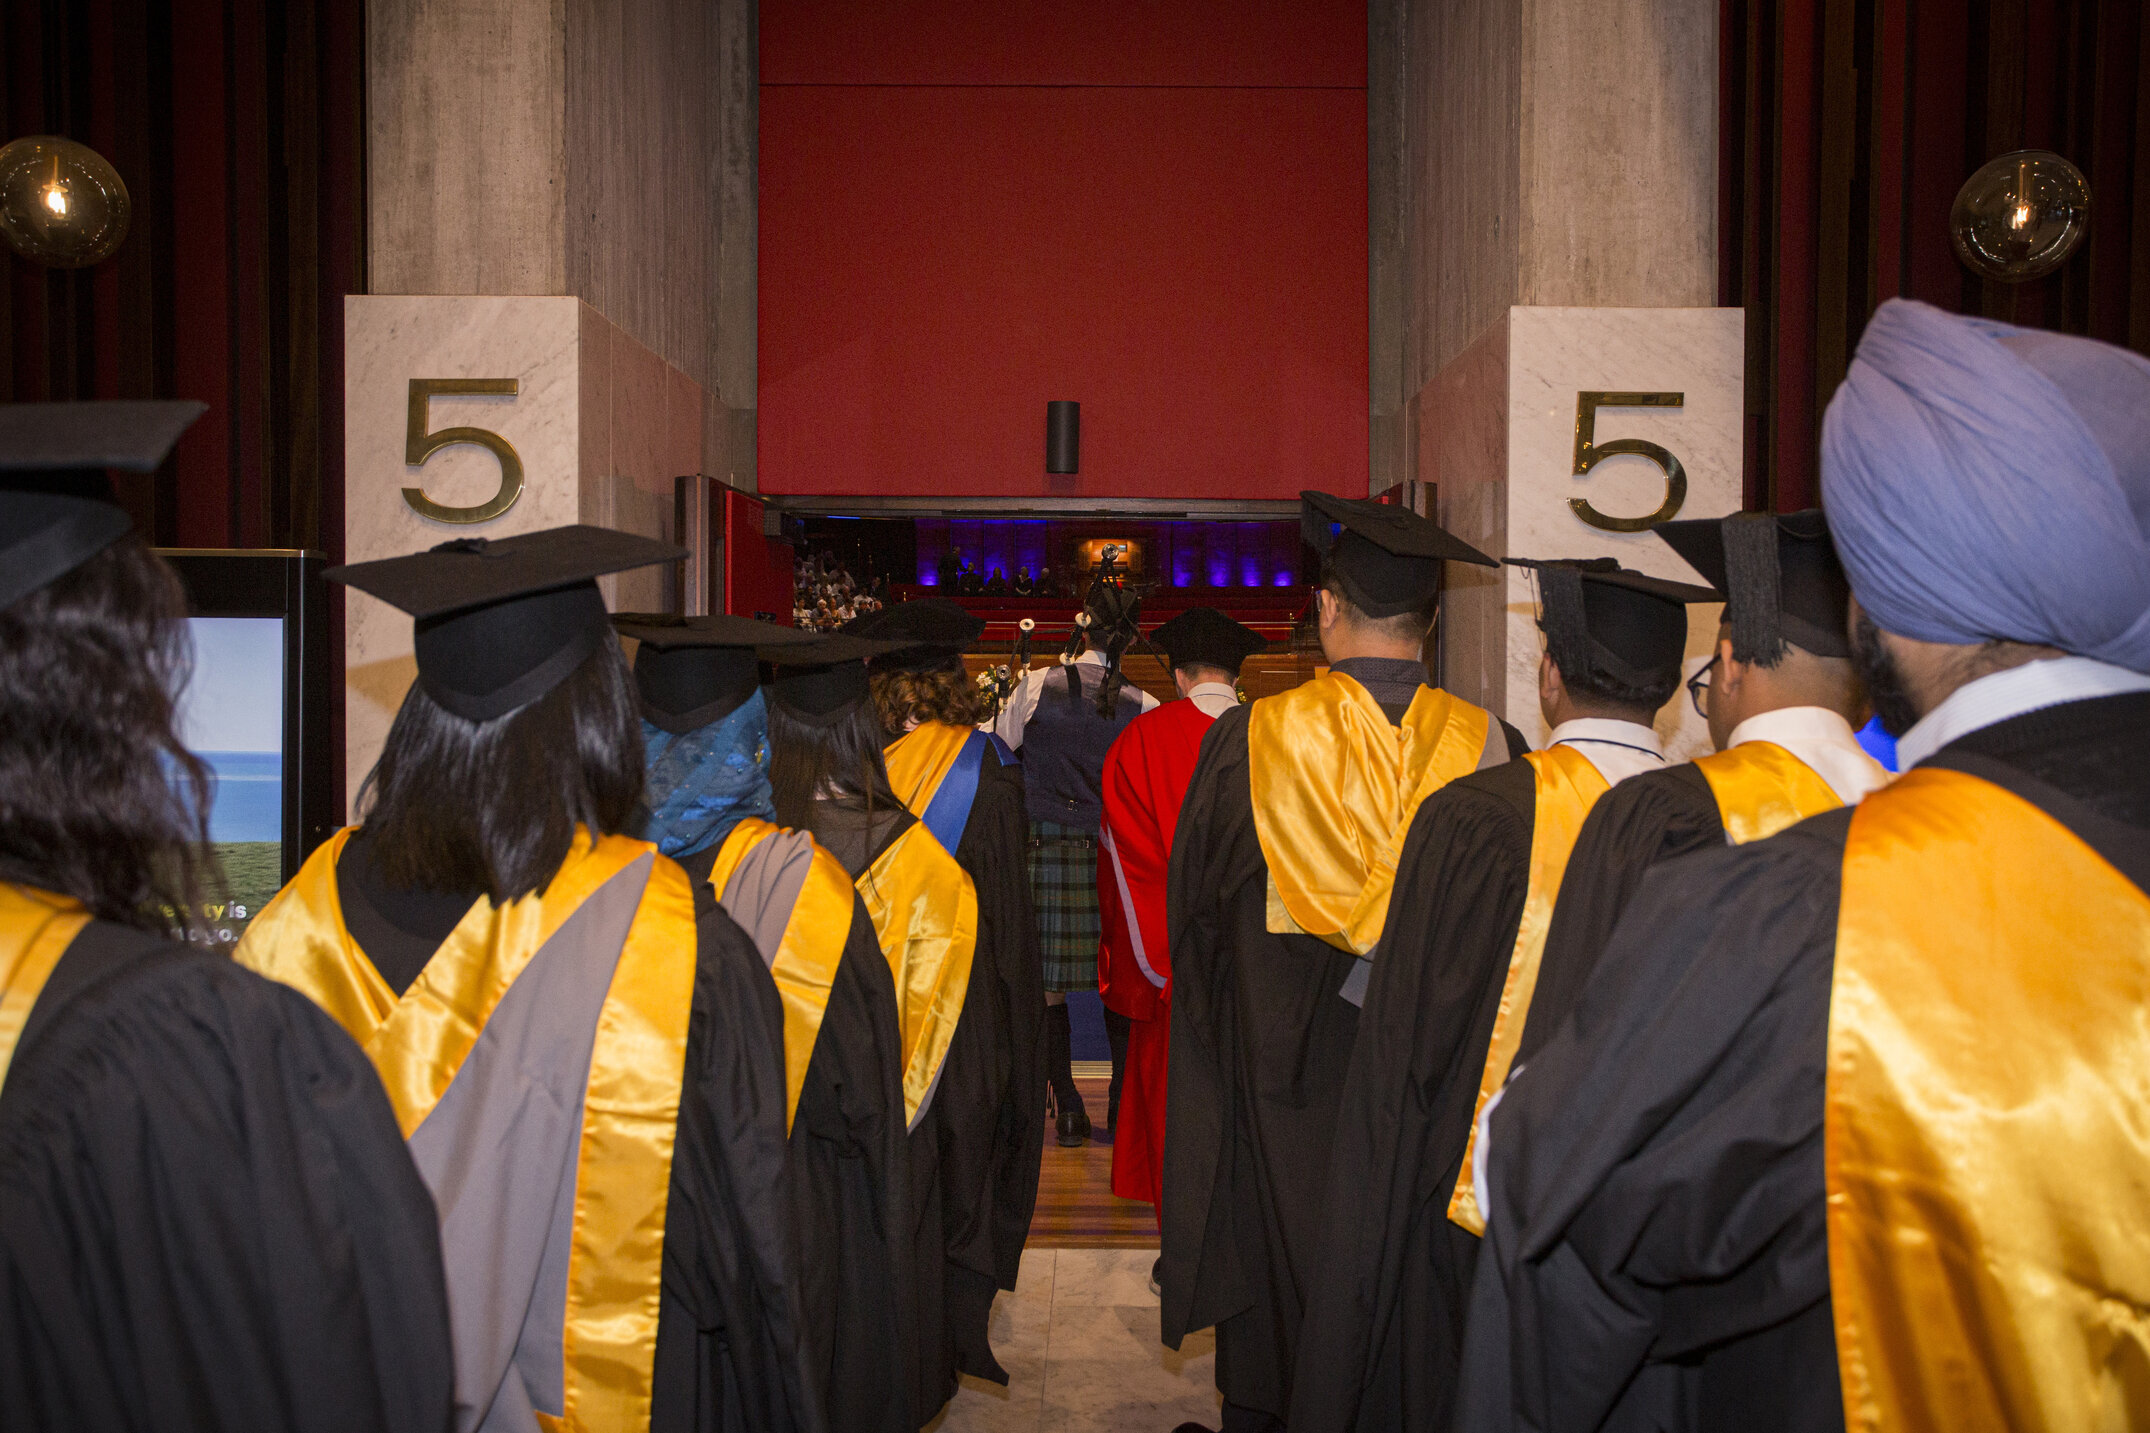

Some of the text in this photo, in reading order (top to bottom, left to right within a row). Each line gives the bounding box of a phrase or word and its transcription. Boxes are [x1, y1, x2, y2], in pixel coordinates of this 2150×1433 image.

[401, 378, 525, 524] 5
[1566, 391, 1687, 532] 5
[229, 900, 247, 919] is
